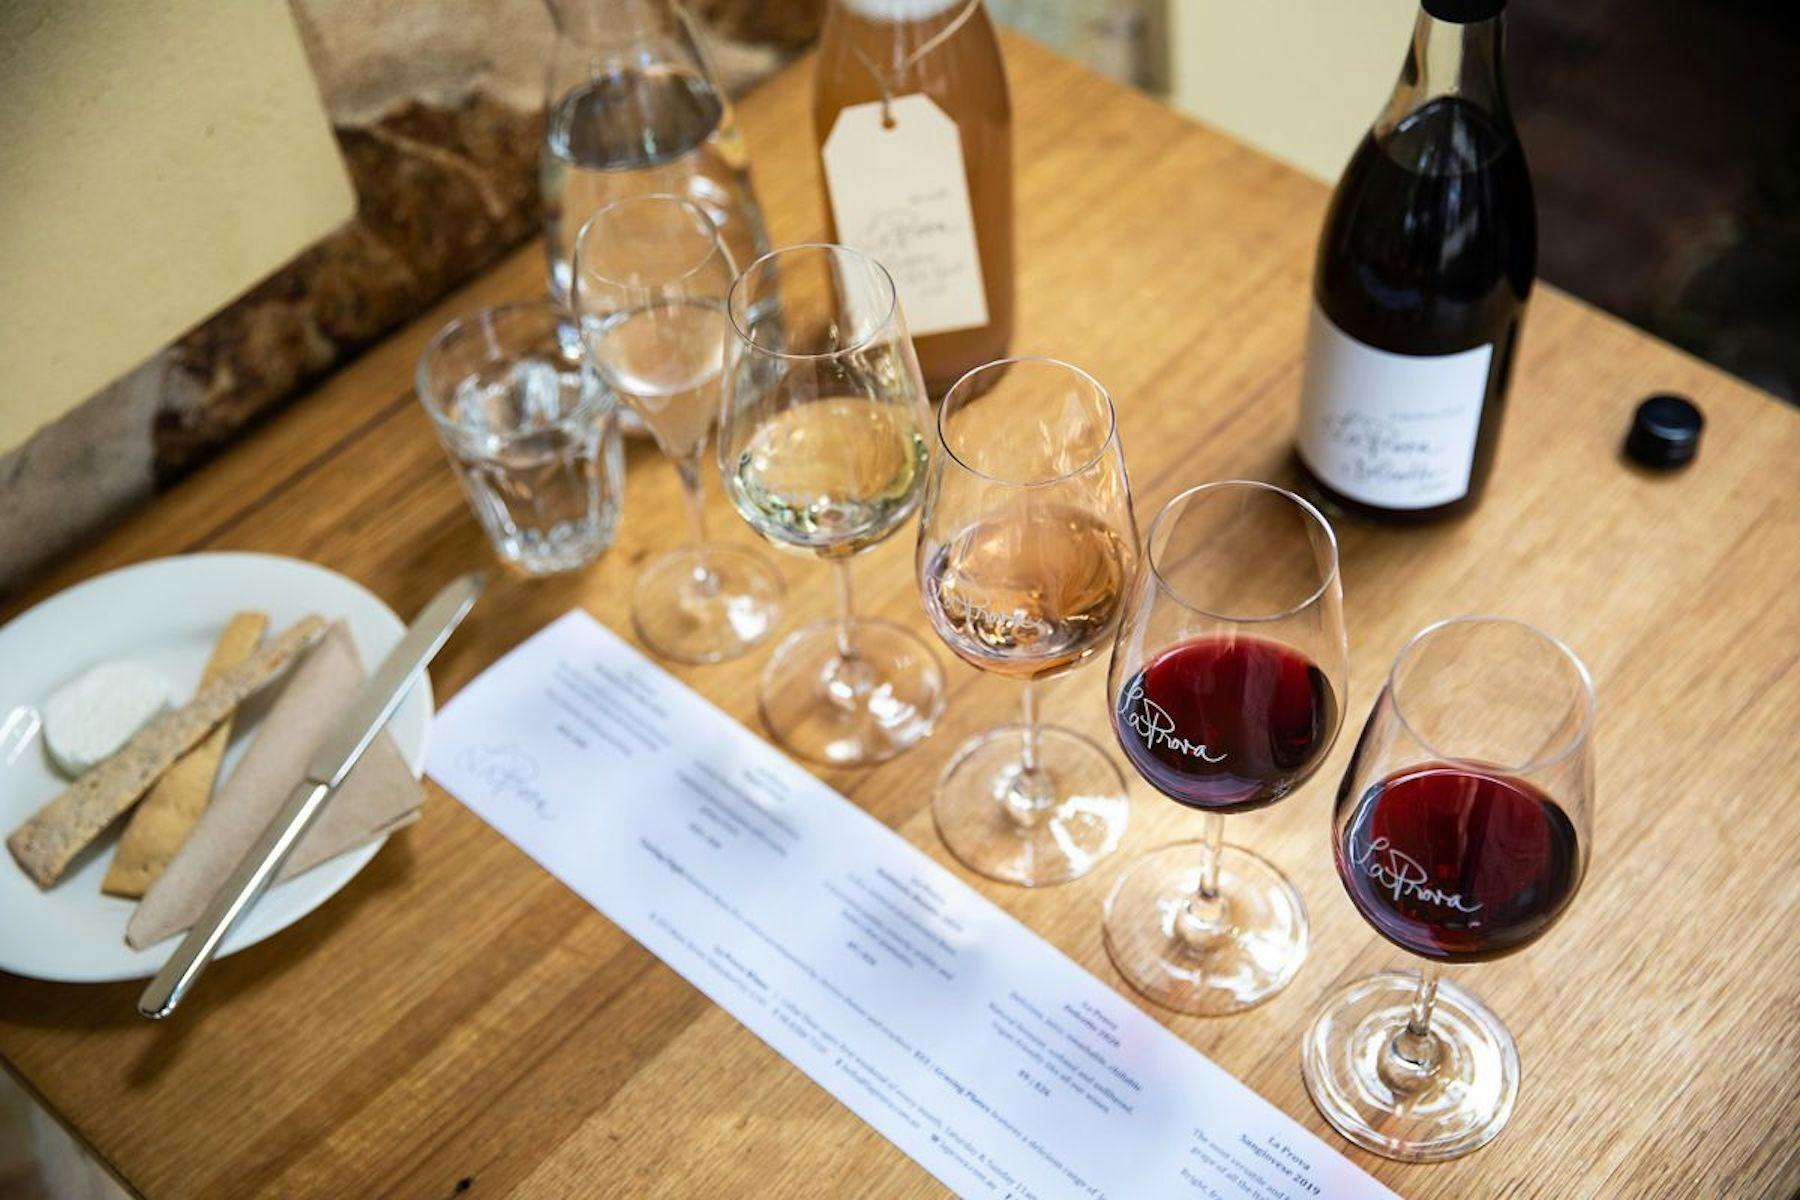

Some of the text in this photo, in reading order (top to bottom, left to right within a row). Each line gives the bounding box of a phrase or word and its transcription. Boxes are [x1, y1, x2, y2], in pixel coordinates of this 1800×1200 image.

[1143, 698, 1227, 763] Prova
[1388, 848, 1484, 913] Prova
[1240, 1134, 1321, 1197] Sangiovese 2019
[1268, 1136, 1311, 1170] La Prova
